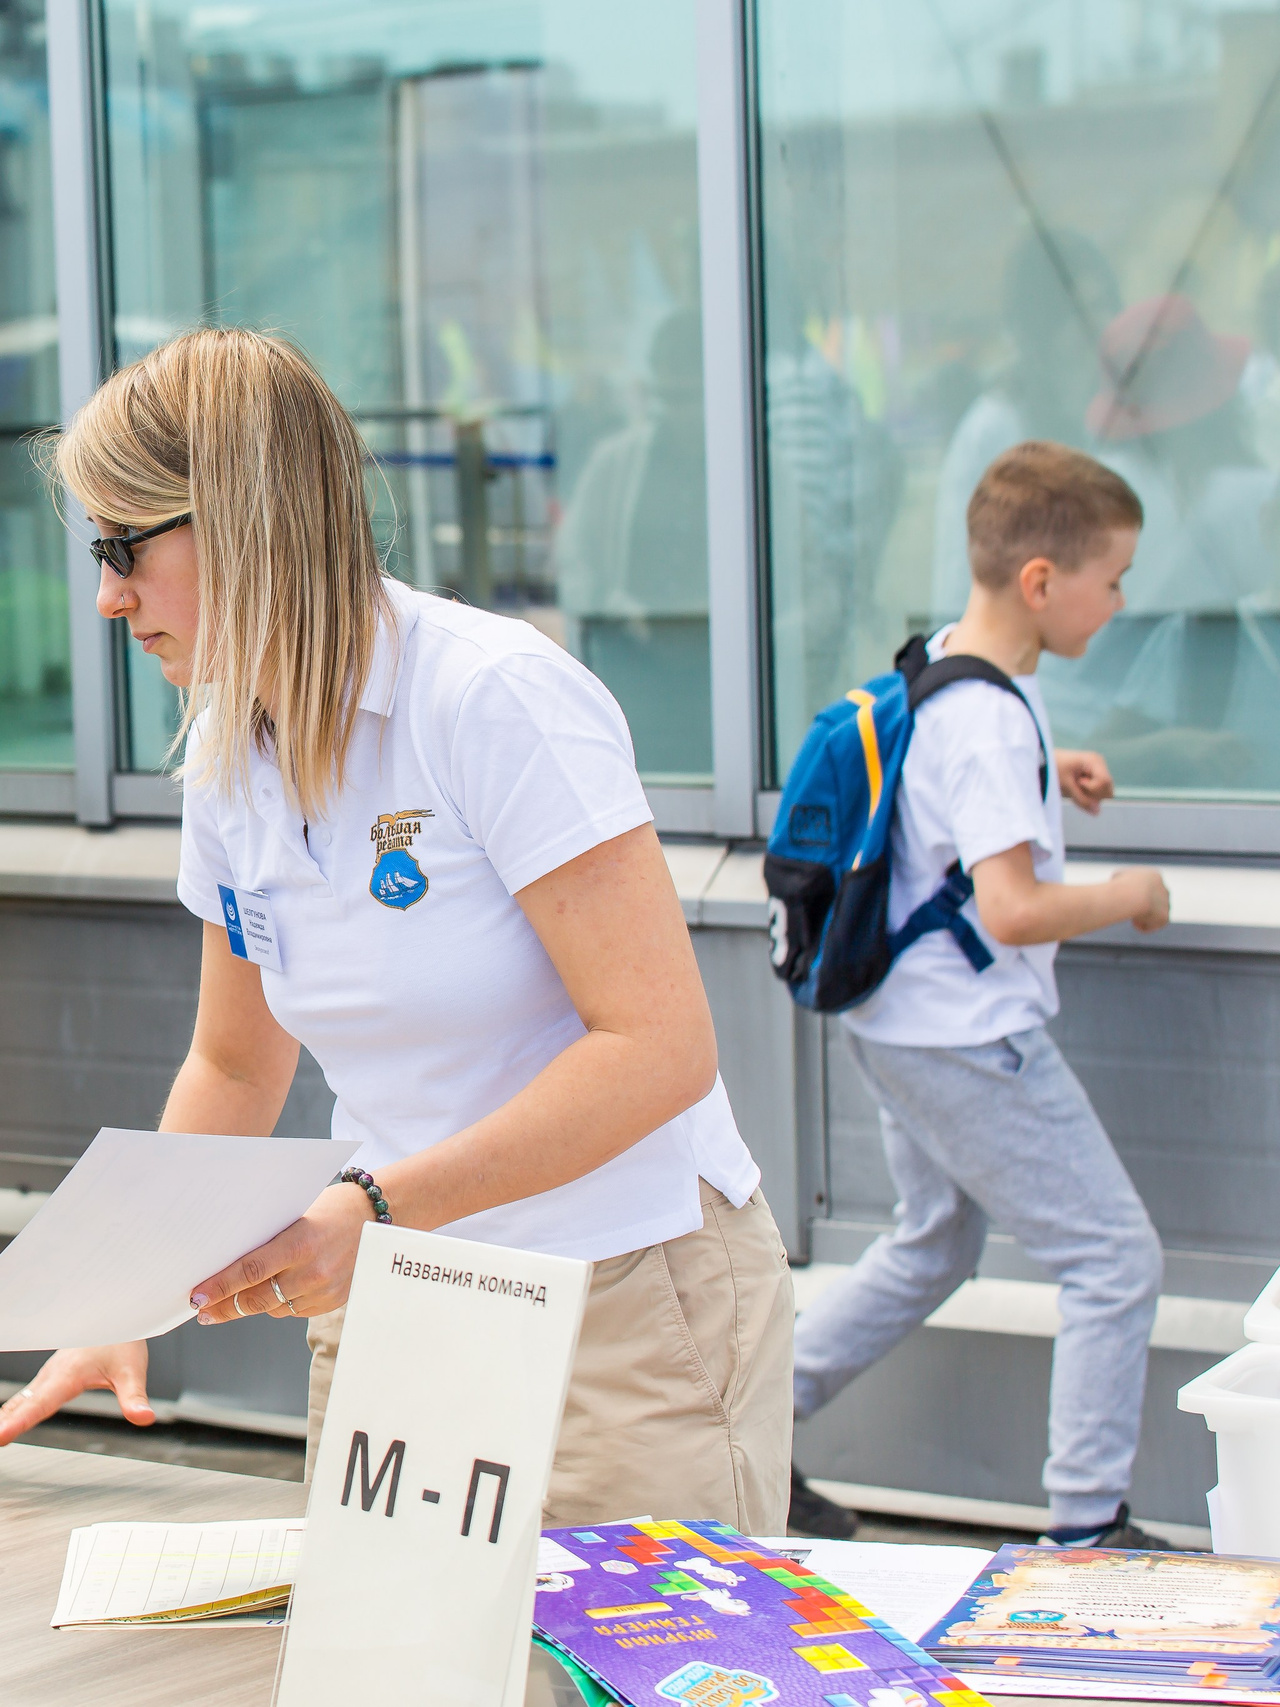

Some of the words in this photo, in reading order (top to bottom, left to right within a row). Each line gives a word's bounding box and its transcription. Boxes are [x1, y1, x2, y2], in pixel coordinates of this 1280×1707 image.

[370, 821, 422, 841] Большая
[376, 834, 413, 854] регата
[391, 1253, 473, 1288] Названия
[477, 1274, 547, 1307] команд
[340, 1430, 406, 1518] М
[460, 1457, 511, 1544] П
[593, 1614, 706, 1636] ГЕЙМЕРА
[615, 1628, 718, 1650] ЖУРНАЛ
